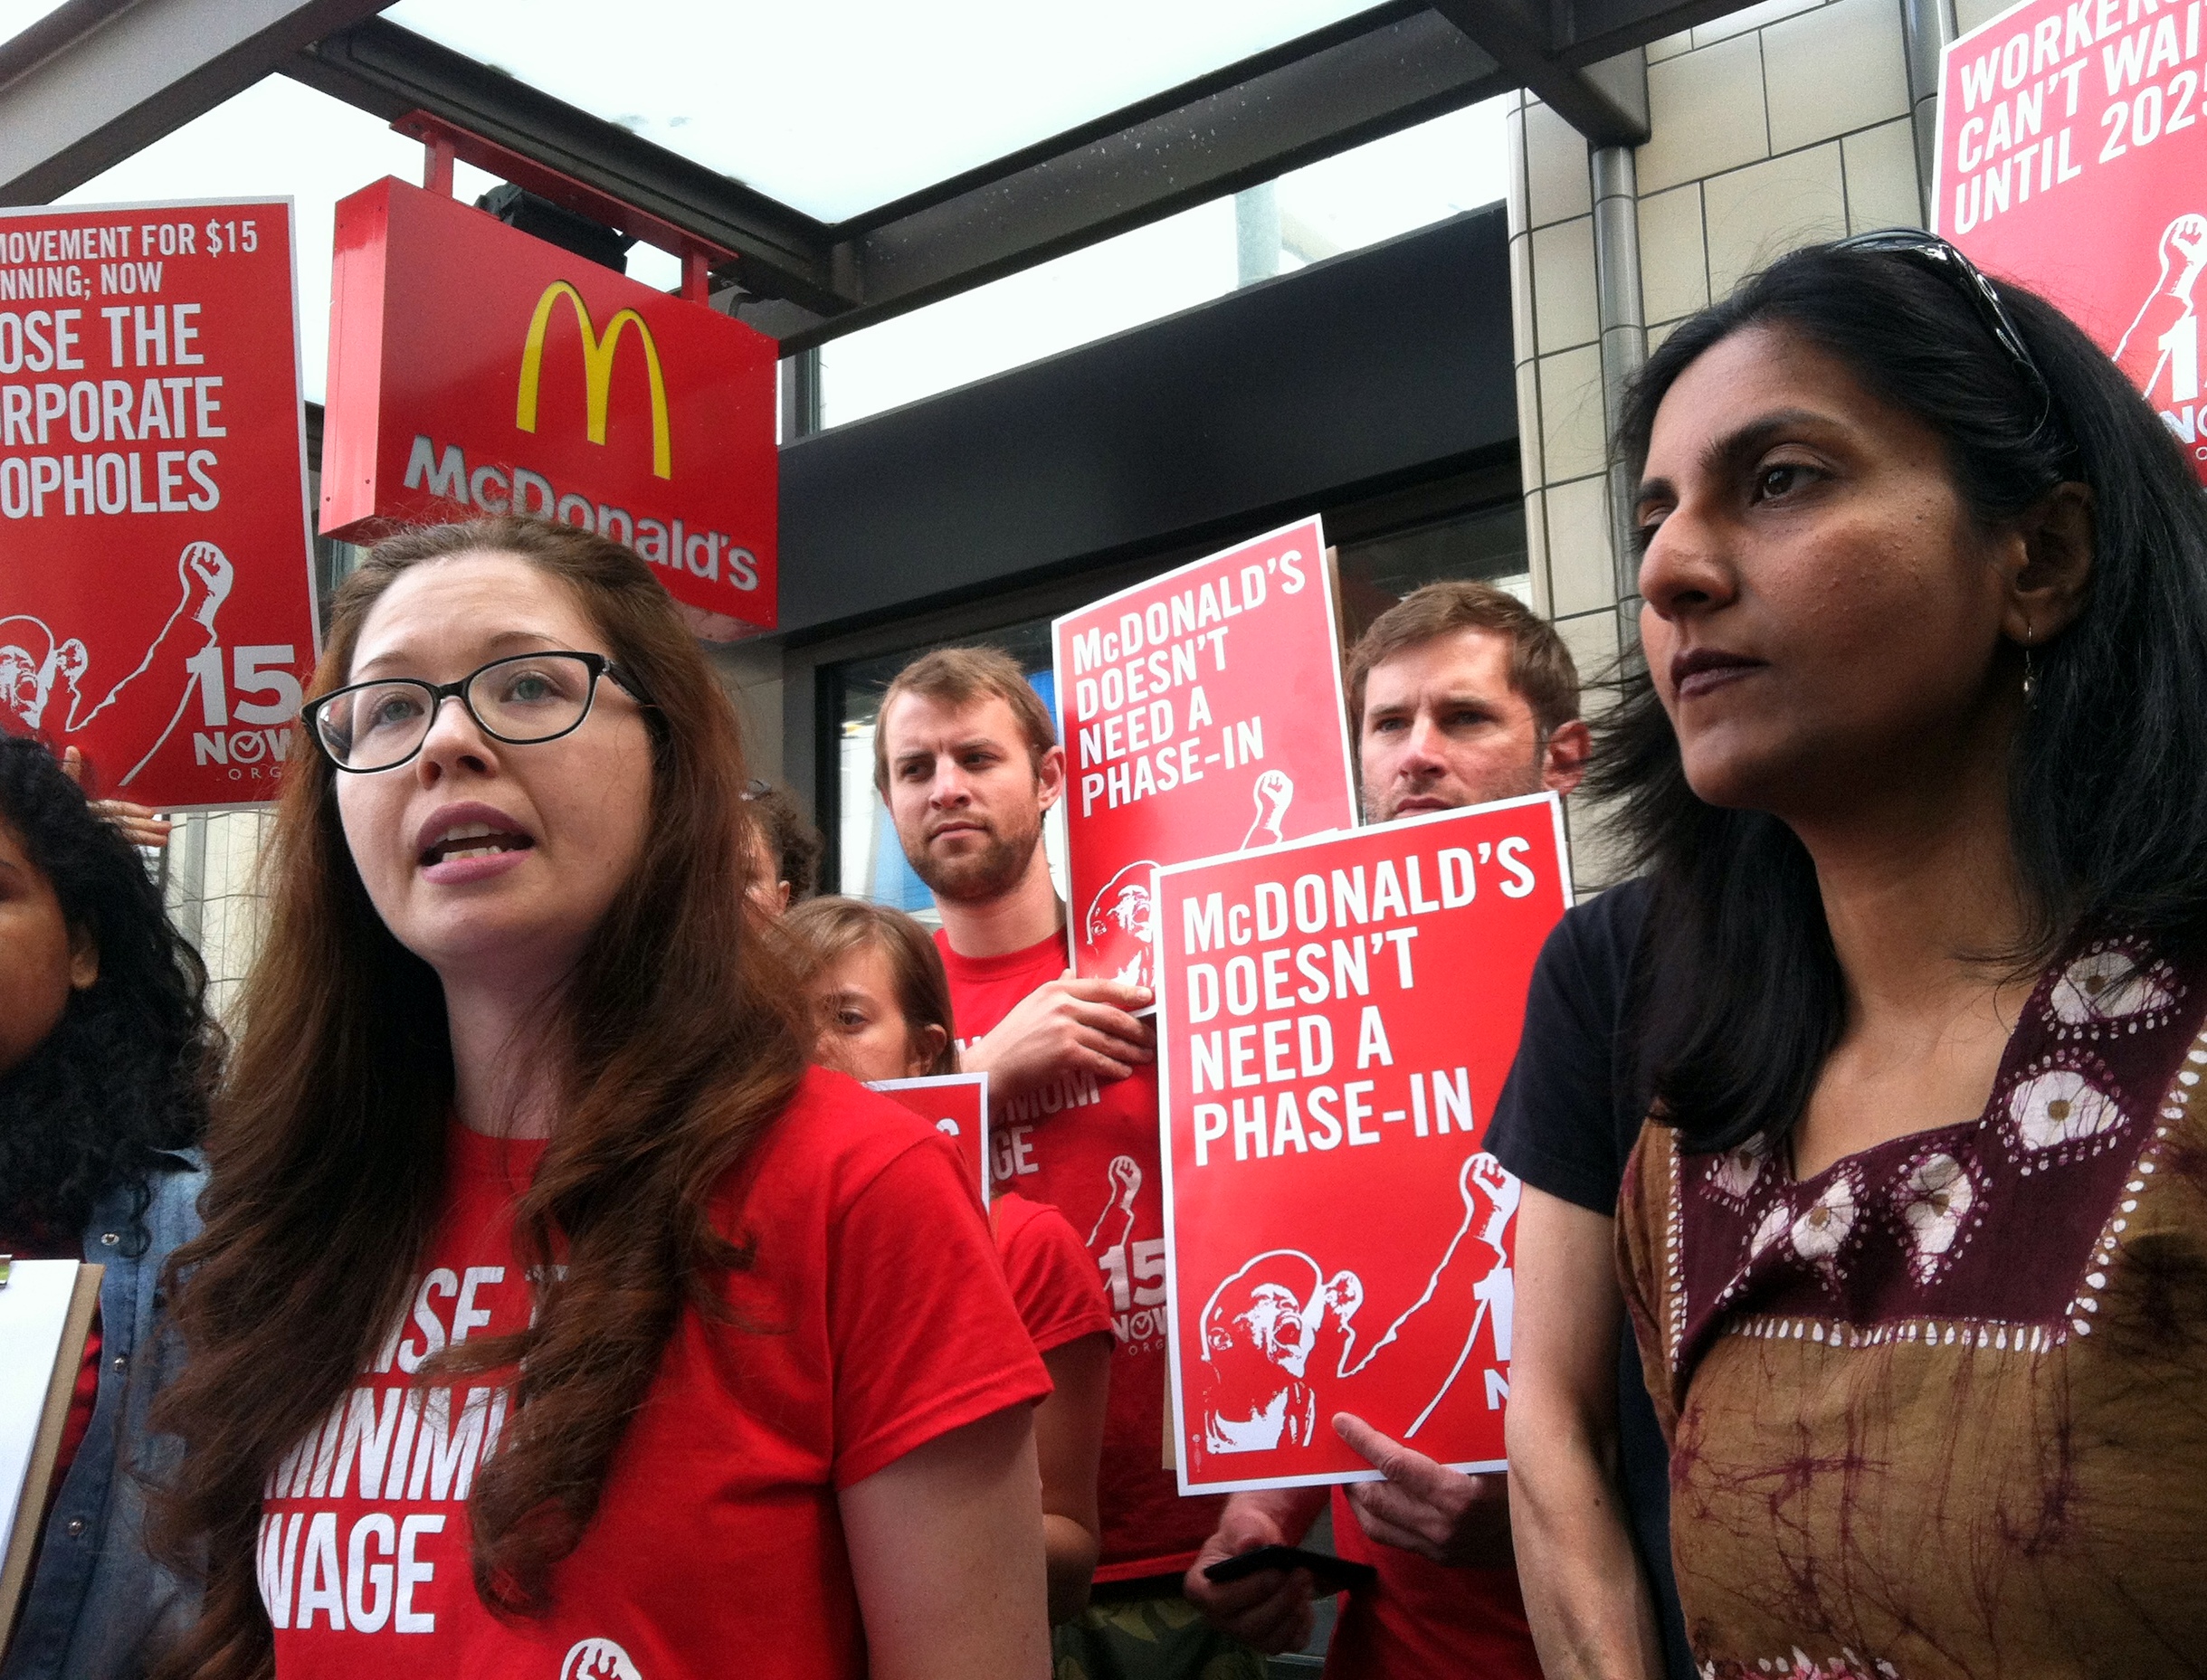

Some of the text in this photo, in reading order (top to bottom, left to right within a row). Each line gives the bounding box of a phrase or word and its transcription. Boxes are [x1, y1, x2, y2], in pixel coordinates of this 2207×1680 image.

[1957, 0, 2207, 173] CAN'T WAI
[1955, 62, 2207, 235] UNTIL 202
[0, 218, 258, 265] OVEMENT FOR $15
[100, 261, 163, 295] NOW
[101, 303, 205, 368] THE
[0, 375, 226, 446] RPORATE
[2, 450, 220, 519] OPHOLES
[404, 434, 758, 591] McDonald's
[186, 644, 303, 726] 15
[1076, 626, 1229, 722] DOESN'T
[1080, 686, 1213, 769] NEED A
[1081, 716, 1264, 818] PHASE-IN
[228, 766, 282, 781] ORG
[1186, 926, 1418, 1023] DOESN'T
[1190, 1005, 1394, 1094] NEED A
[990, 1125, 1039, 1184] GE
[1194, 1067, 1474, 1166] PHASE-IN
[256, 1513, 446, 1633] WAGE
